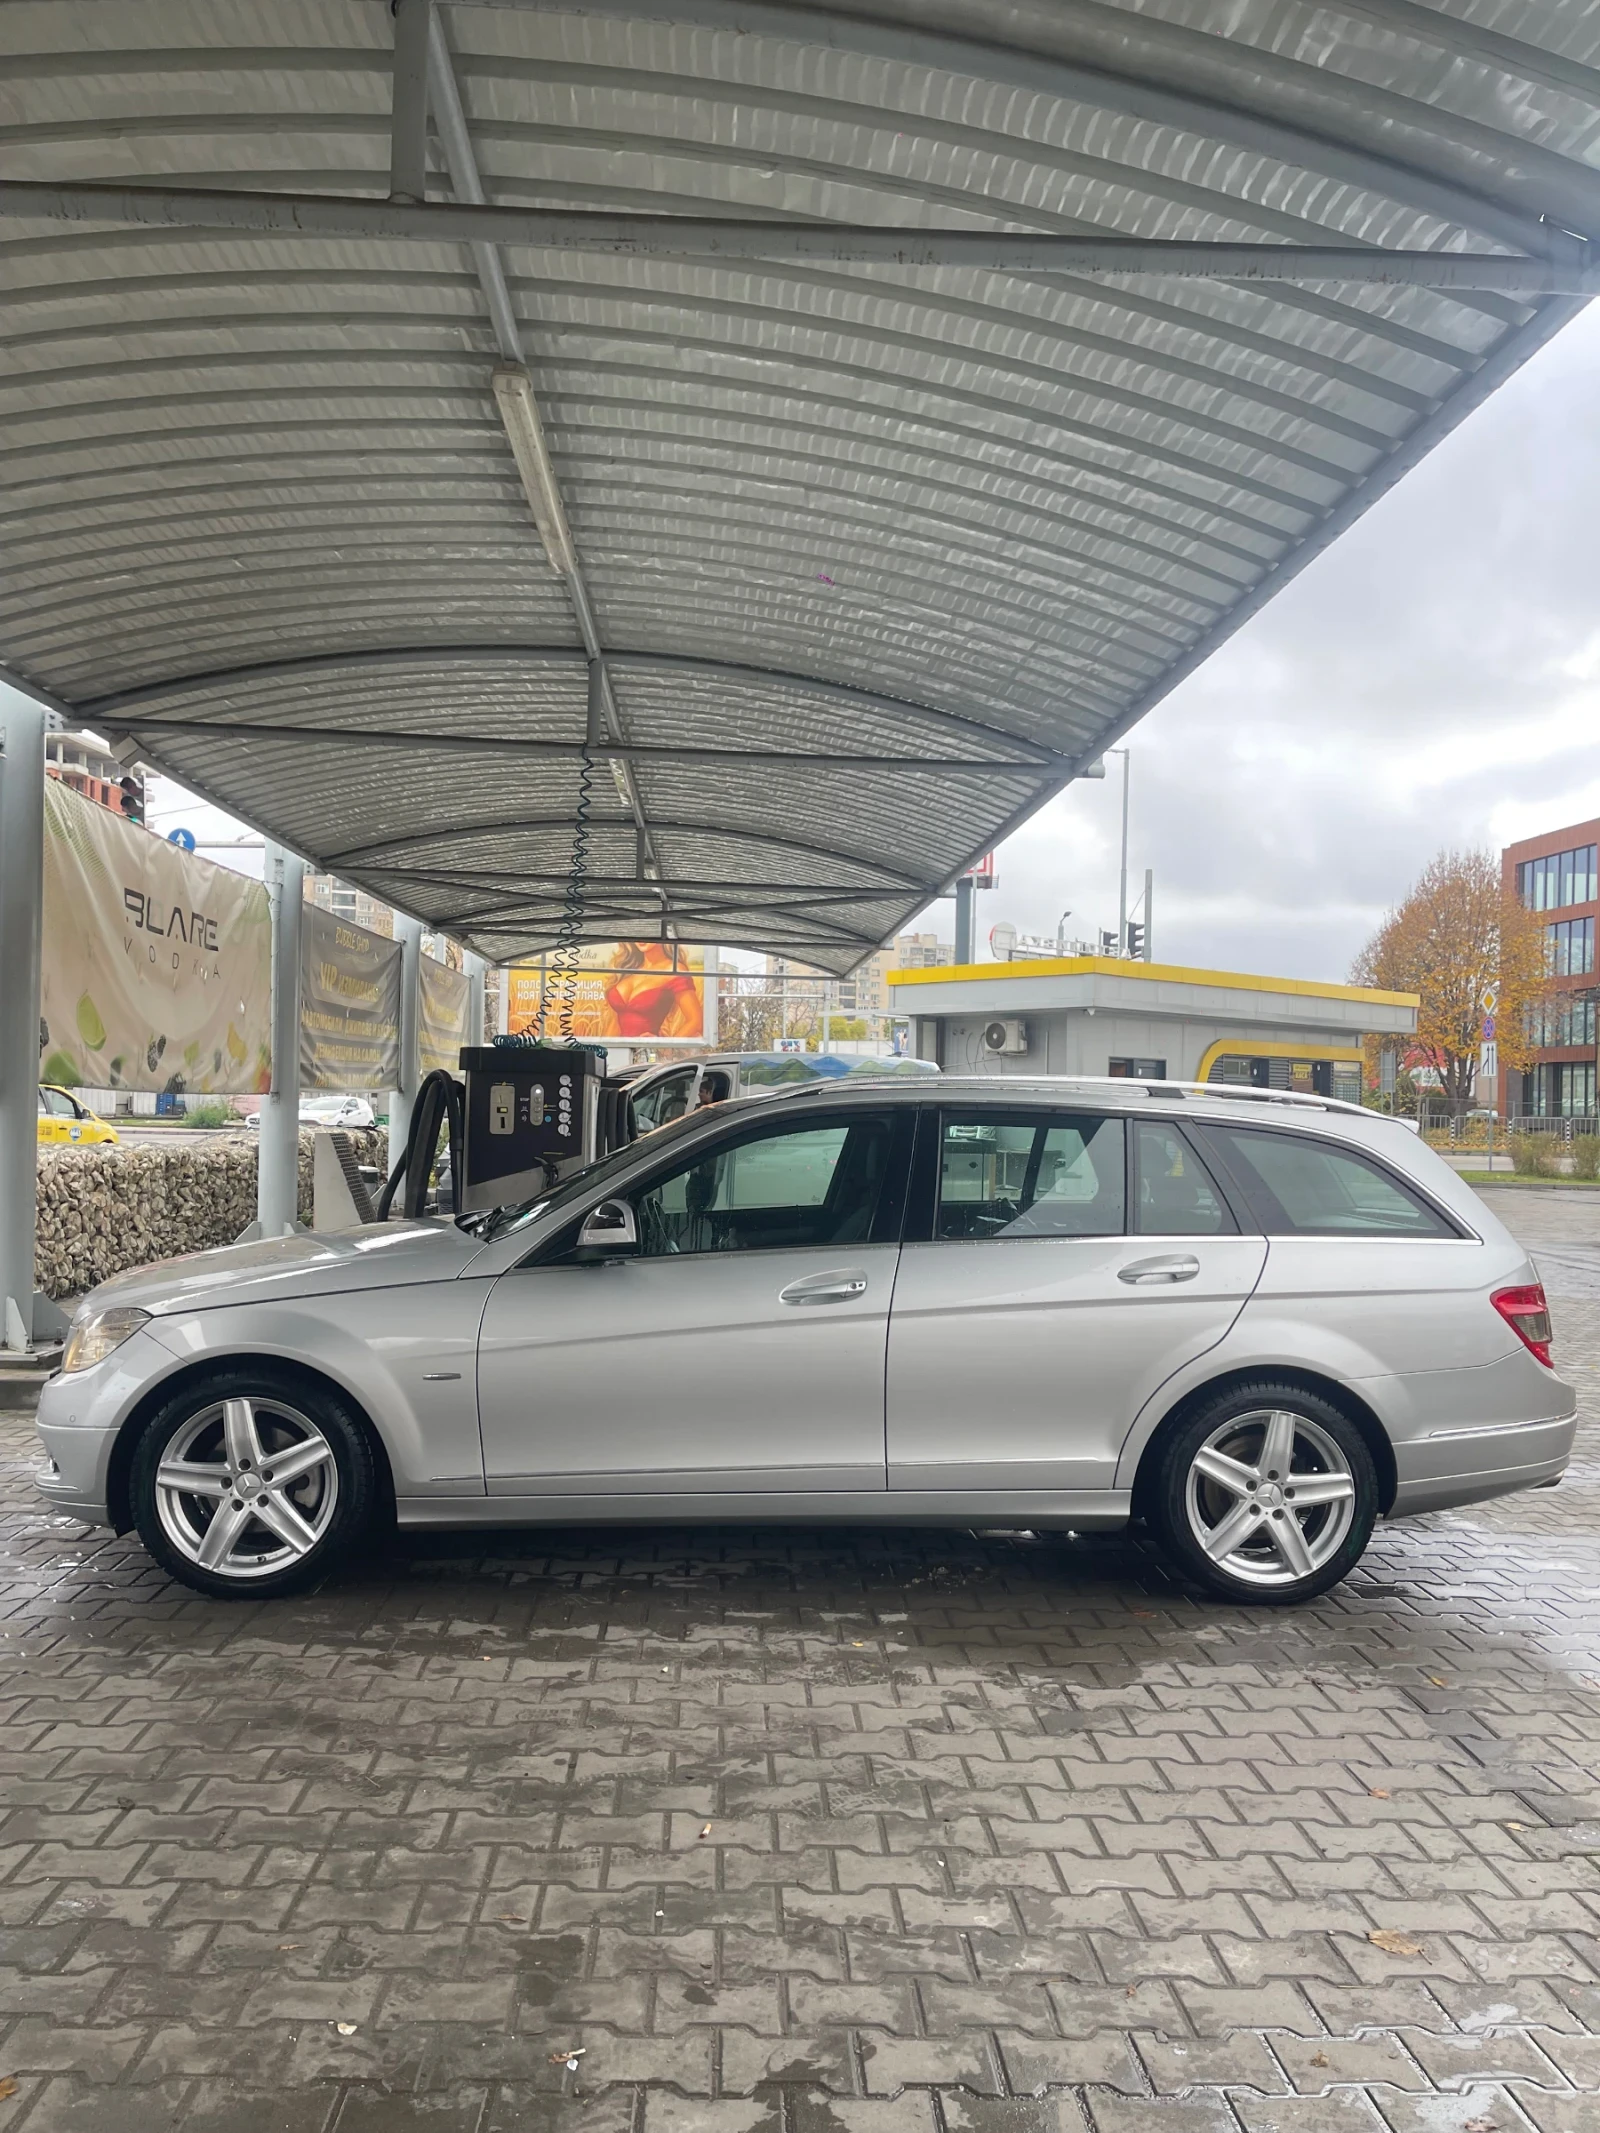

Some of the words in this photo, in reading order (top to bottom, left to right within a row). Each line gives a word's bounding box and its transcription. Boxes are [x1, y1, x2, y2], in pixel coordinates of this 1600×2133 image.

[123, 887, 219, 952] BLARE
[123, 936, 221, 979] VODKA
[320, 962, 338, 992] VIP
[517, 991, 542, 1000] КОЯТ
